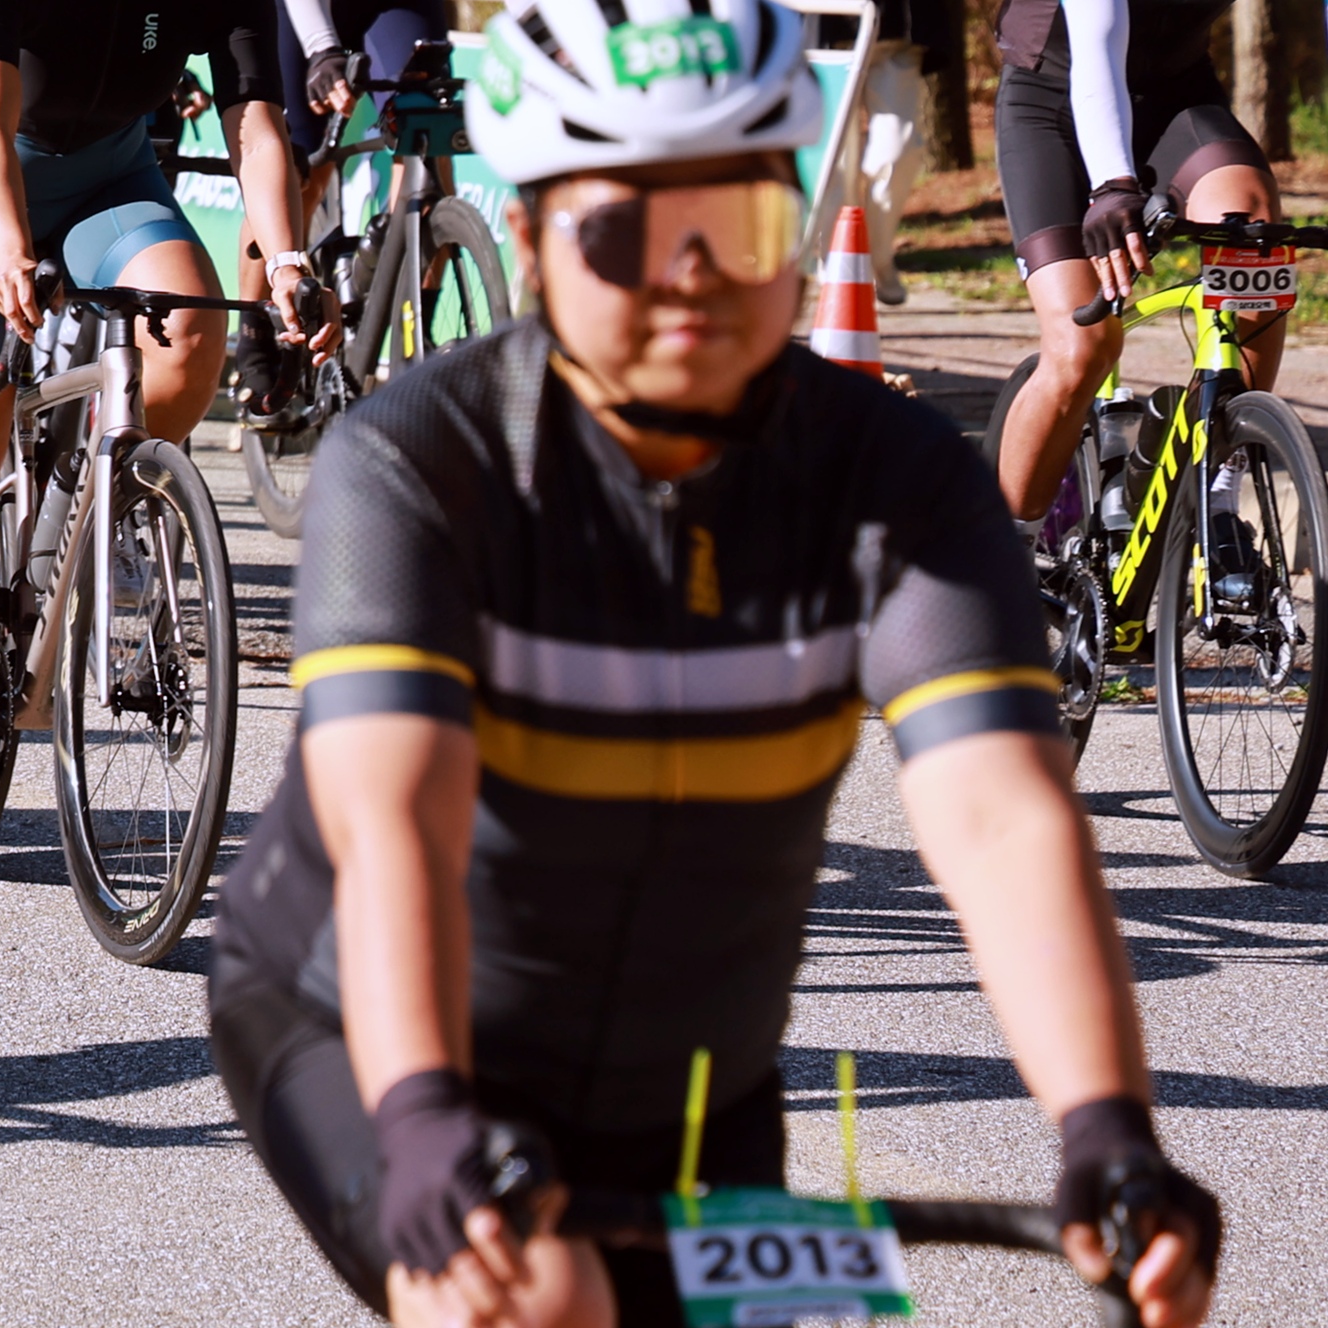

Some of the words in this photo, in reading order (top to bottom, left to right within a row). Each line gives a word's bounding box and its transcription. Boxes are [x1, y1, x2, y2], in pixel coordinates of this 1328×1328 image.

[1207, 267, 1291, 293] 3006
[1112, 389, 1190, 606] SCOTT
[697, 1230, 880, 1284] 2013
